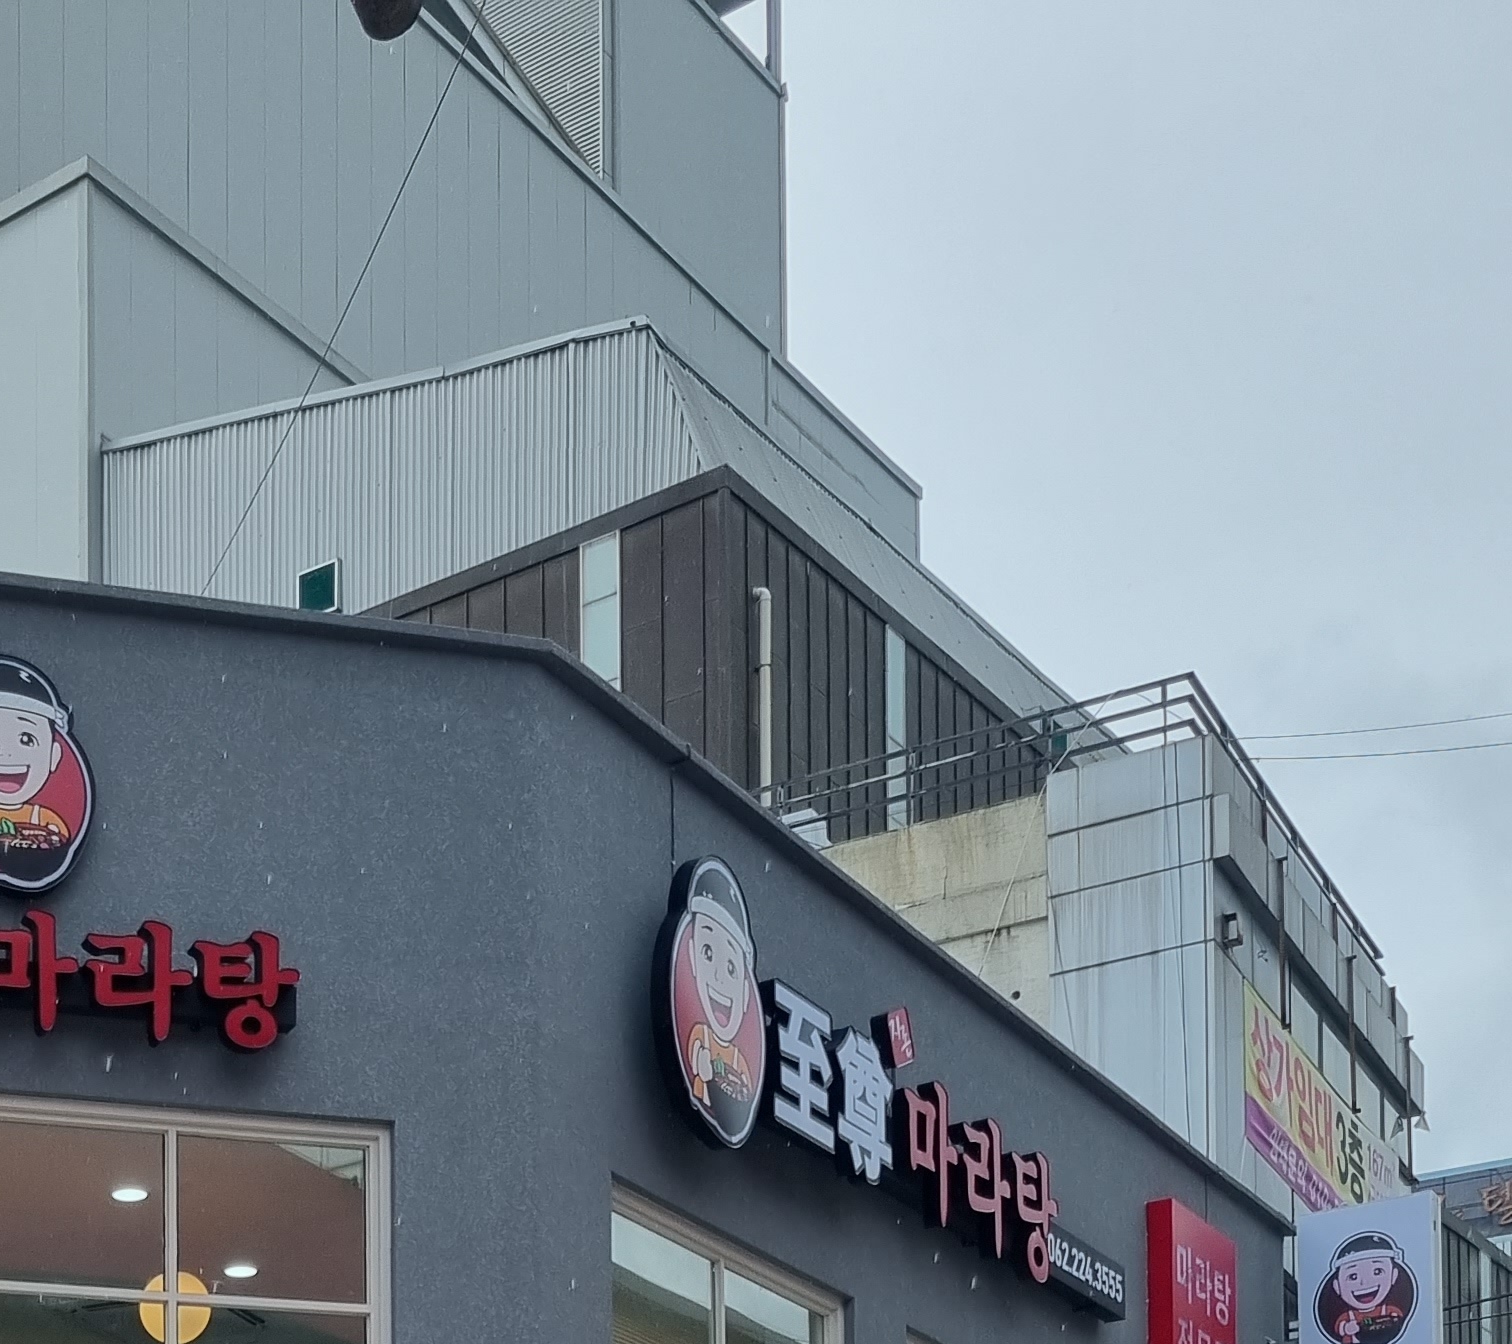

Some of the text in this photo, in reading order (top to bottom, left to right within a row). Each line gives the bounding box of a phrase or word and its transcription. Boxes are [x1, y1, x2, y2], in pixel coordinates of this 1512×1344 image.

[774, 980, 1059, 1283] 至尊 마라탕
[1047, 1232, 1124, 1304] 062.224.3555
[1176, 1244, 1232, 1326] 마라탕
